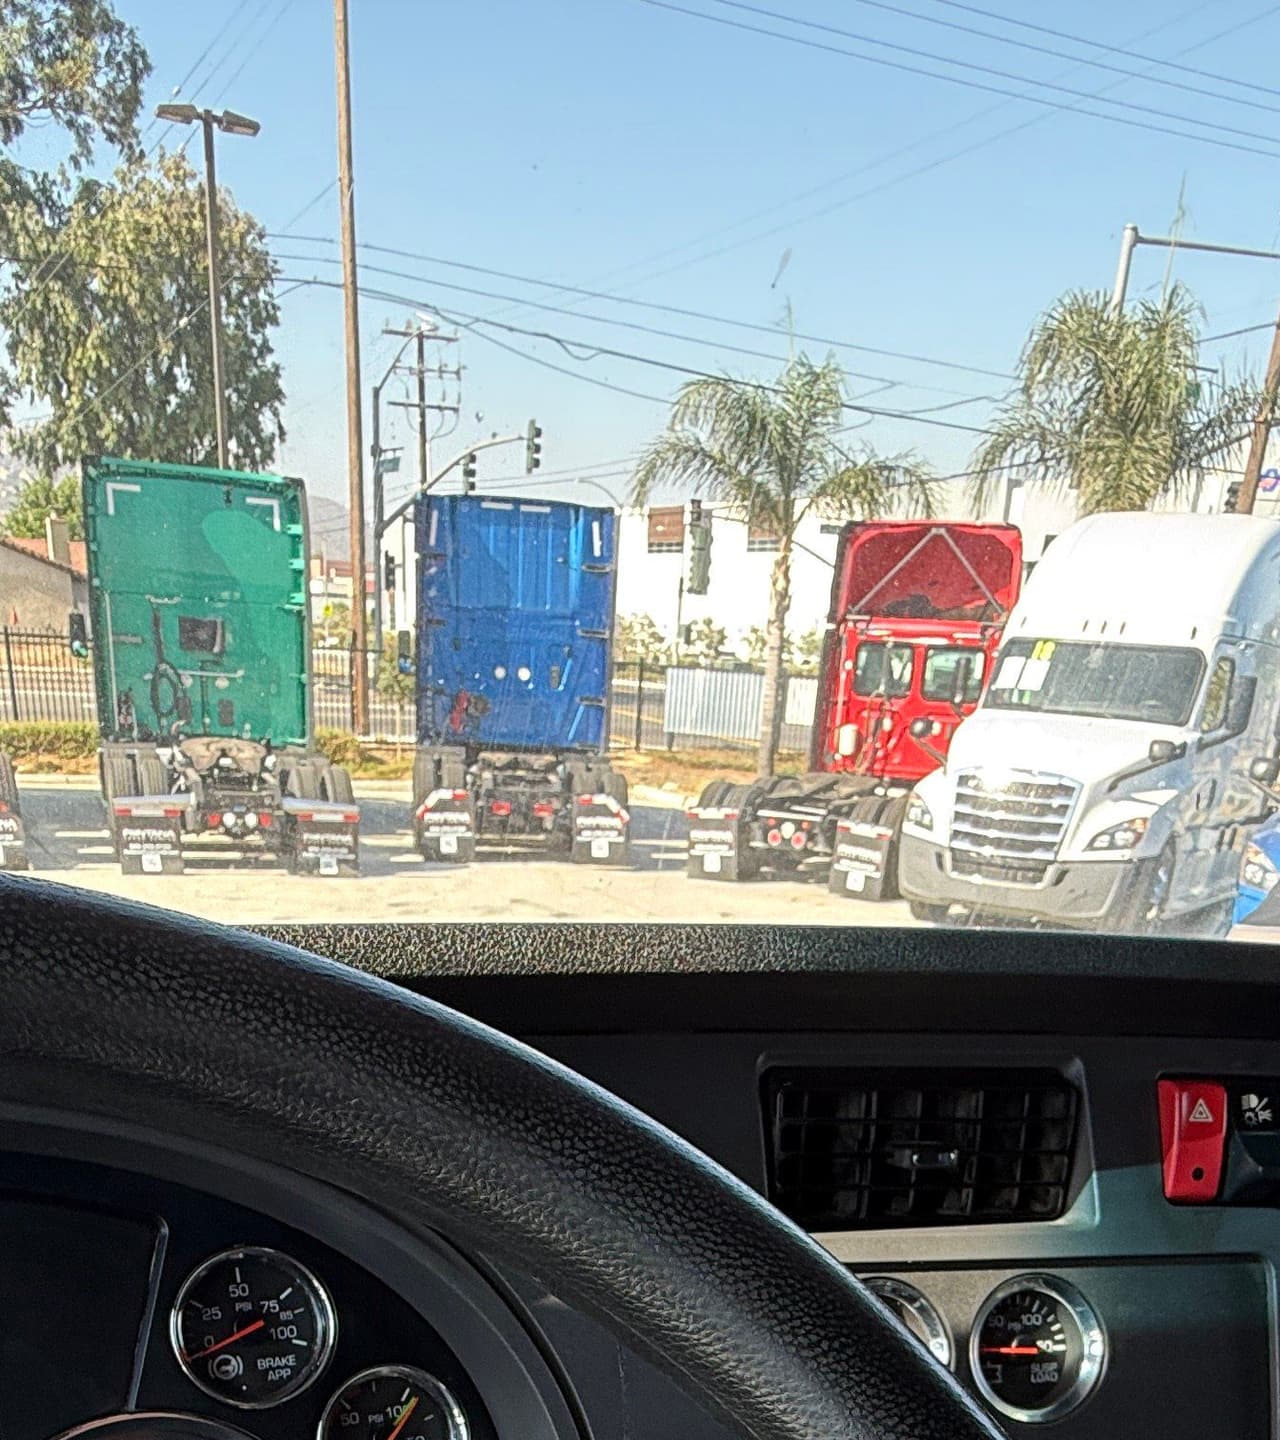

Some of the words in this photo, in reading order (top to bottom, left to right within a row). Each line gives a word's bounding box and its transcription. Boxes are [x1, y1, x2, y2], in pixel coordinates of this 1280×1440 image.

[228, 1284, 249, 1298] 50
[201, 1306, 222, 1321] 25
[235, 1302, 253, 1312] PSI
[260, 1300, 280, 1314] 75
[1020, 1313, 1043, 1327] 100
[269, 1325, 298, 1340] 100
[203, 1335, 215, 1348] 0
[256, 1354, 296, 1370] BRAKE
[267, 1368, 292, 1381] APP
[341, 1412, 360, 1426] 50
